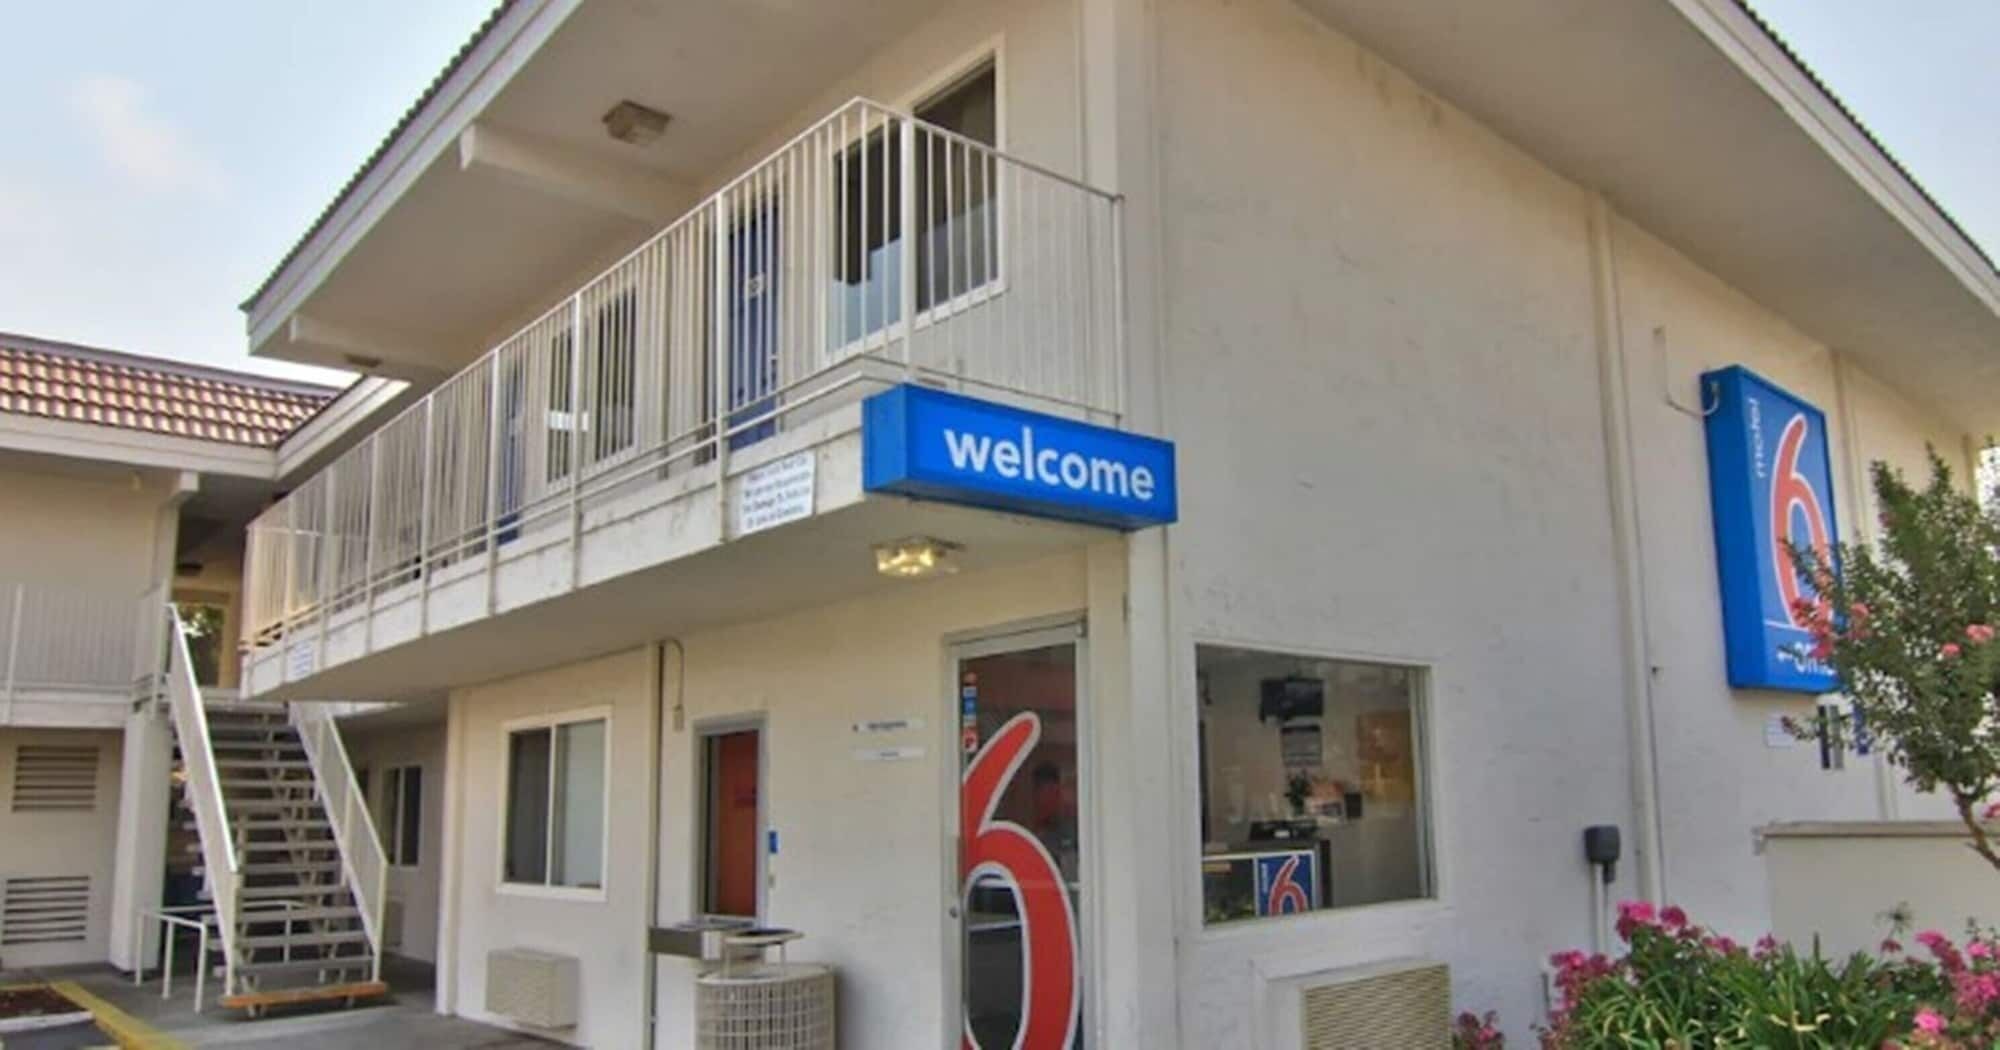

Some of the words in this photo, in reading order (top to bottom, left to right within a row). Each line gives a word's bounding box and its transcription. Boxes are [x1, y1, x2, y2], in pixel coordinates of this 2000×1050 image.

[944, 426, 1154, 500] welcome
[1770, 412, 1833, 631] 6
[963, 711, 1078, 1050] 6
[1269, 854, 1307, 917] 6
